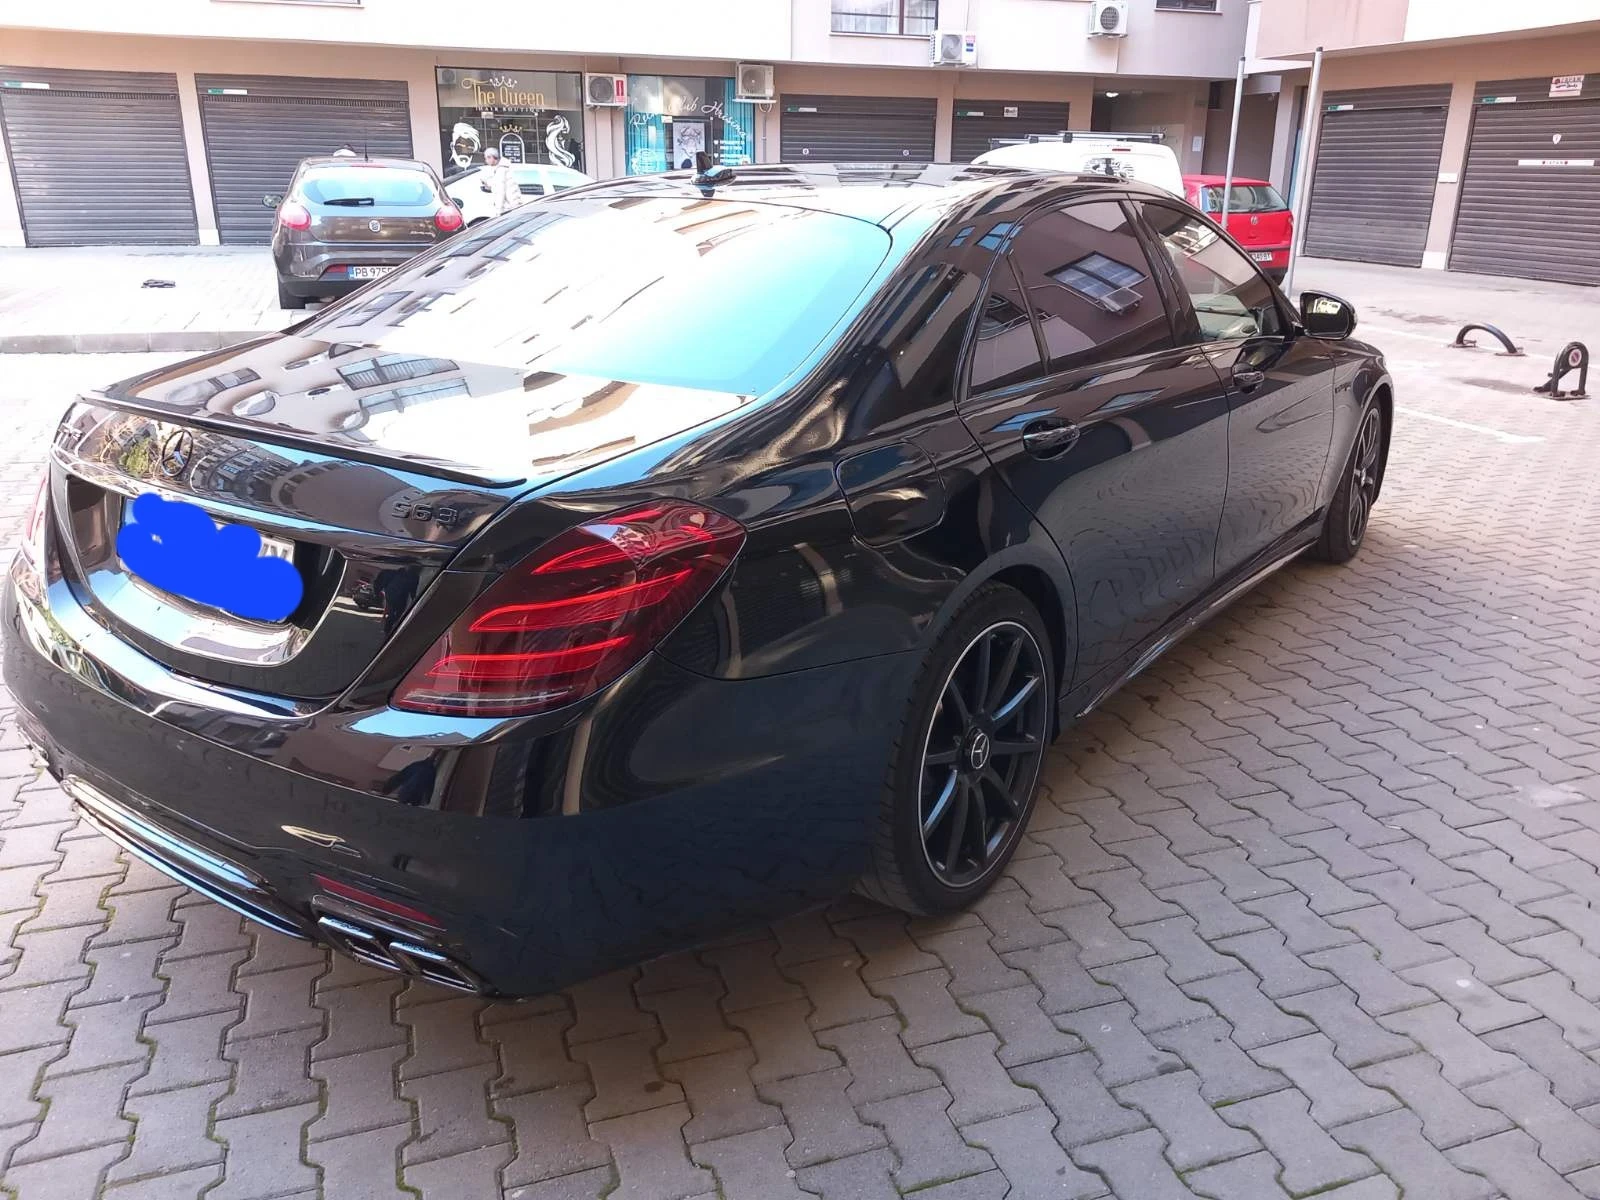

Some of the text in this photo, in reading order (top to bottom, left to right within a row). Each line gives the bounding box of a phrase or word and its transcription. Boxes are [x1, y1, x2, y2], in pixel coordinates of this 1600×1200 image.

[461, 78, 545, 109] The Queen
[502, 106, 546, 114] BOUTIQUE
[355, 267, 368, 277] PB
